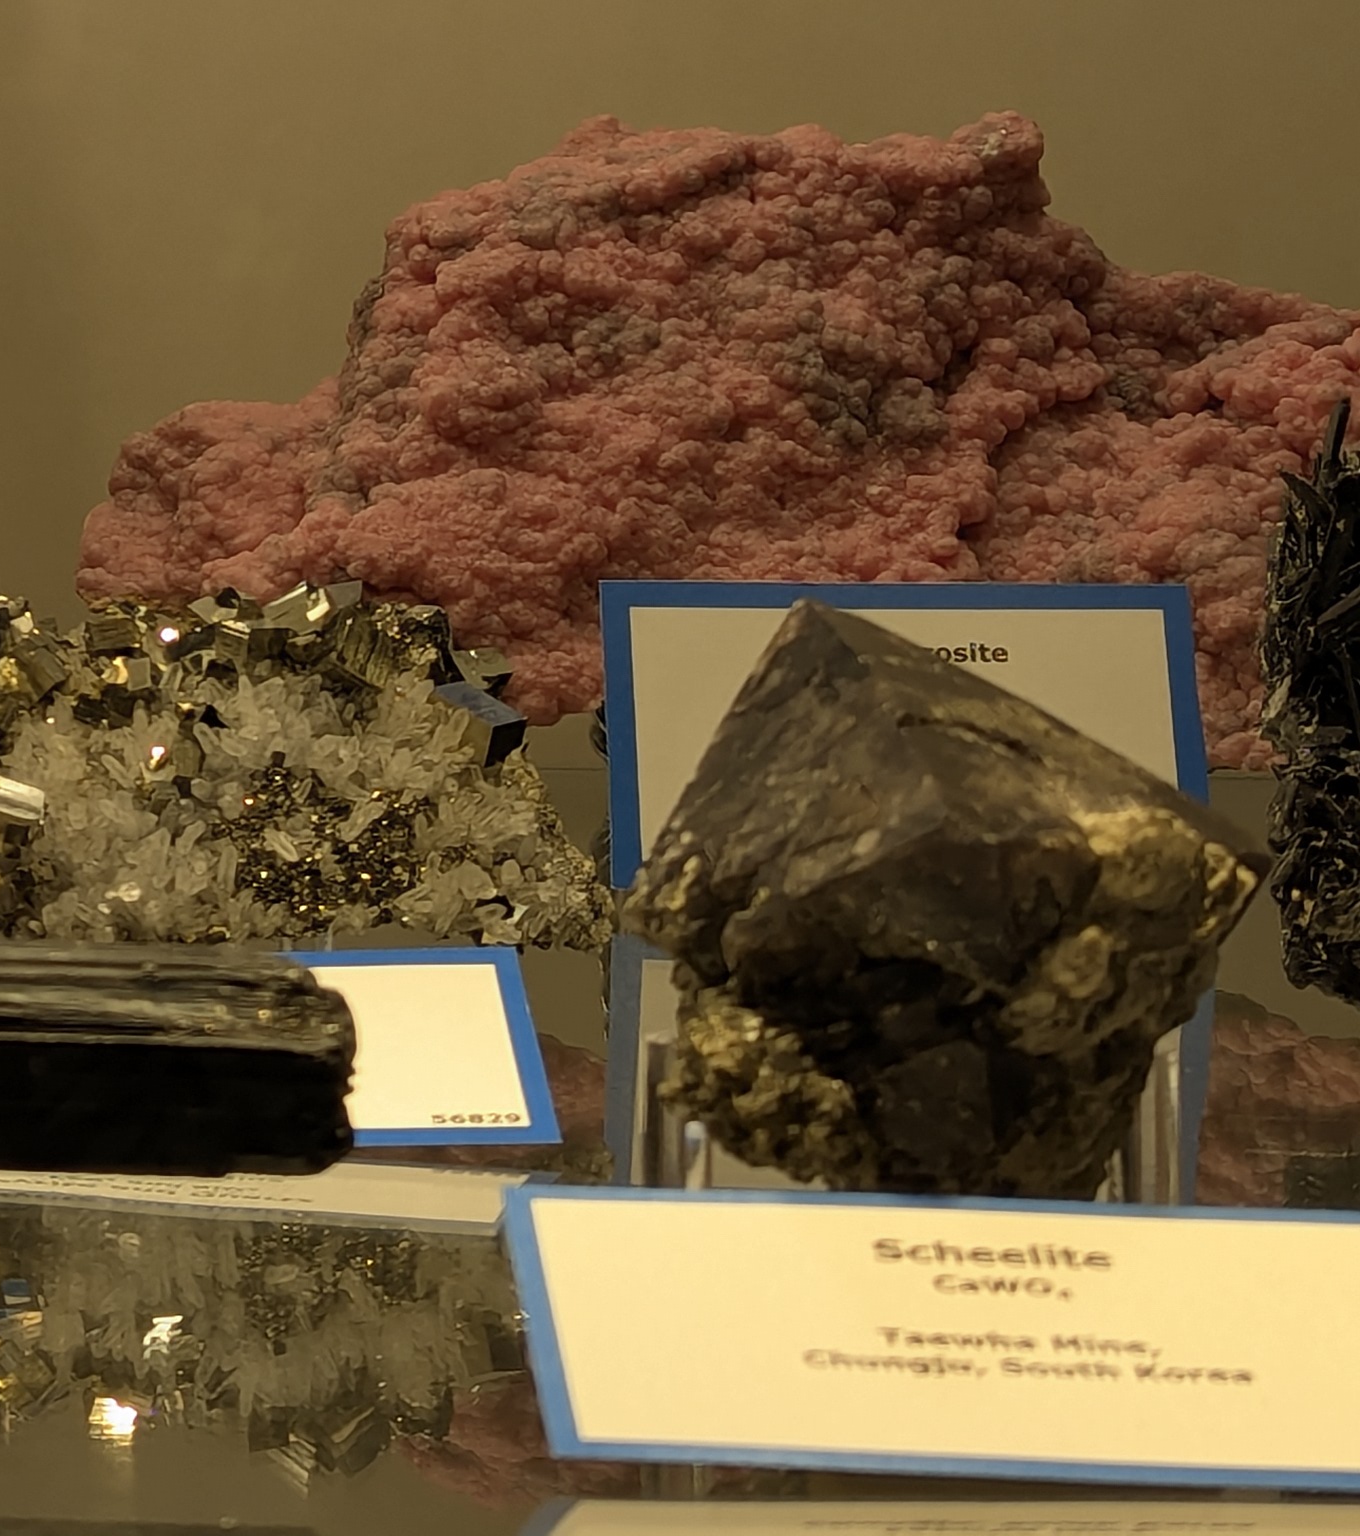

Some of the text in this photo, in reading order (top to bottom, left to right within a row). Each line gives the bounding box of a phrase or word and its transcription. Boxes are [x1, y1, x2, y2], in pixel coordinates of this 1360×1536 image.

[925, 642, 1009, 663] osite
[872, 1237, 1112, 1271] Scheelite
[1050, 1333, 1162, 1360] Mine,
[998, 1355, 1121, 1382] South
[1132, 1363, 1254, 1387] Korea
